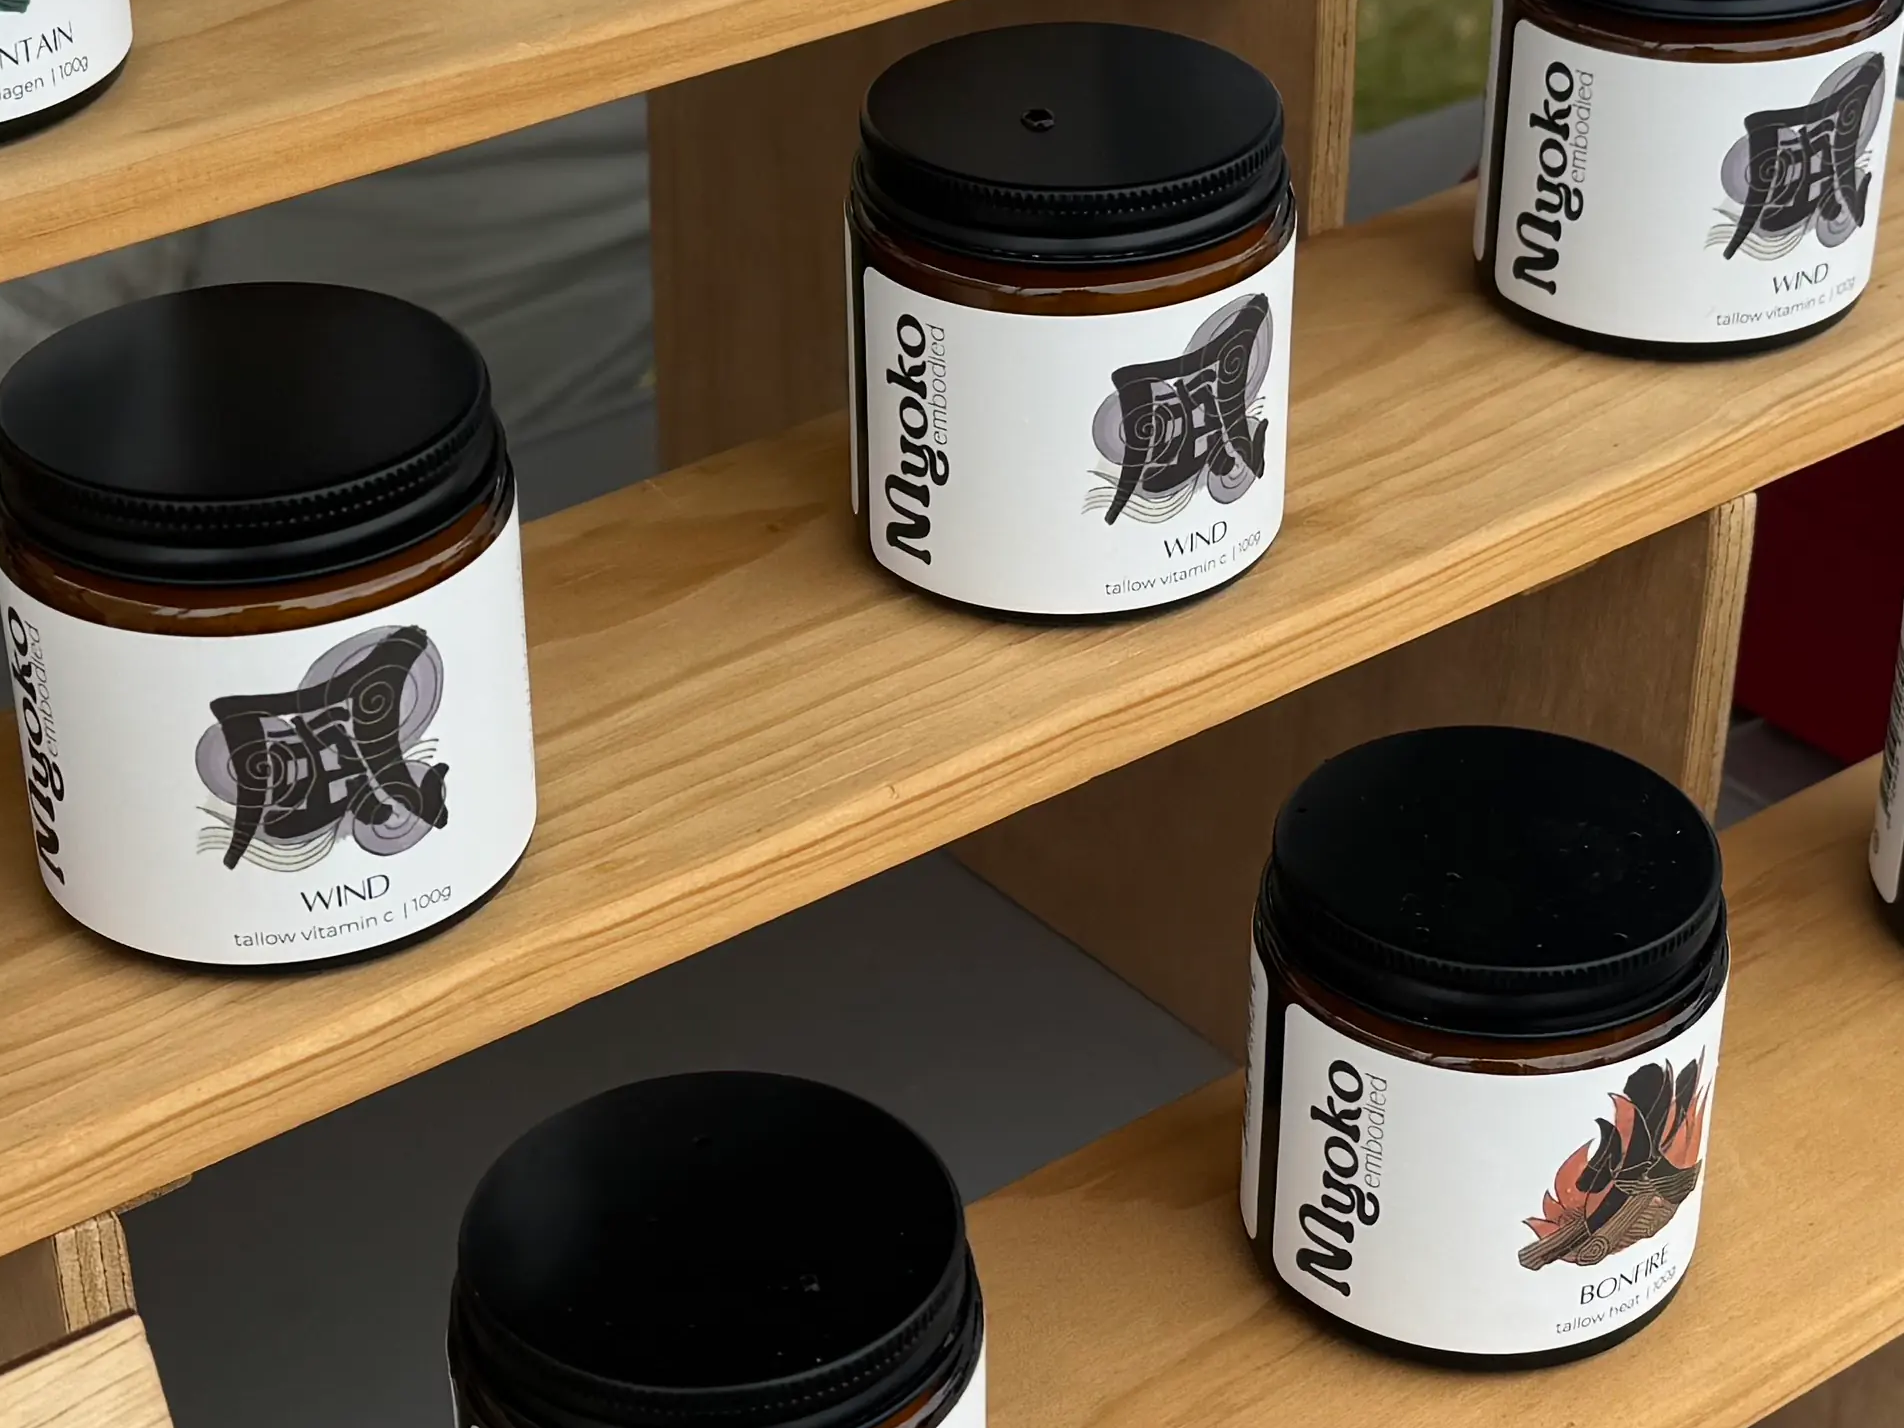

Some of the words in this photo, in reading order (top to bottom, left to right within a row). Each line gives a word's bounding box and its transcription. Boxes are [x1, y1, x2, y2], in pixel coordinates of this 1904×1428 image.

[1571, 69, 1595, 185] embodied
[1512, 61, 1582, 295] Myoko
[1716, 312, 1762, 326] tallow
[1772, 263, 1829, 294] WIND
[933, 323, 948, 445] embodied
[885, 313, 949, 565] Myoko
[1105, 578, 1156, 595] tallow
[1160, 559, 1215, 585] vitamin
[1163, 521, 1227, 558] WIND
[28, 620, 59, 759] embodied
[8, 605, 65, 886] Myoko
[234, 932, 296, 947] tallow
[301, 916, 378, 941] vitamin
[383, 910, 394, 922] c
[412, 885, 452, 912] 100g
[300, 874, 390, 912] WIND
[1363, 1074, 1388, 1189] embodied
[1296, 1058, 1379, 1297] Myoko
[1580, 1242, 1669, 1305] BONFIRE
[1556, 1312, 1605, 1334] tallow
